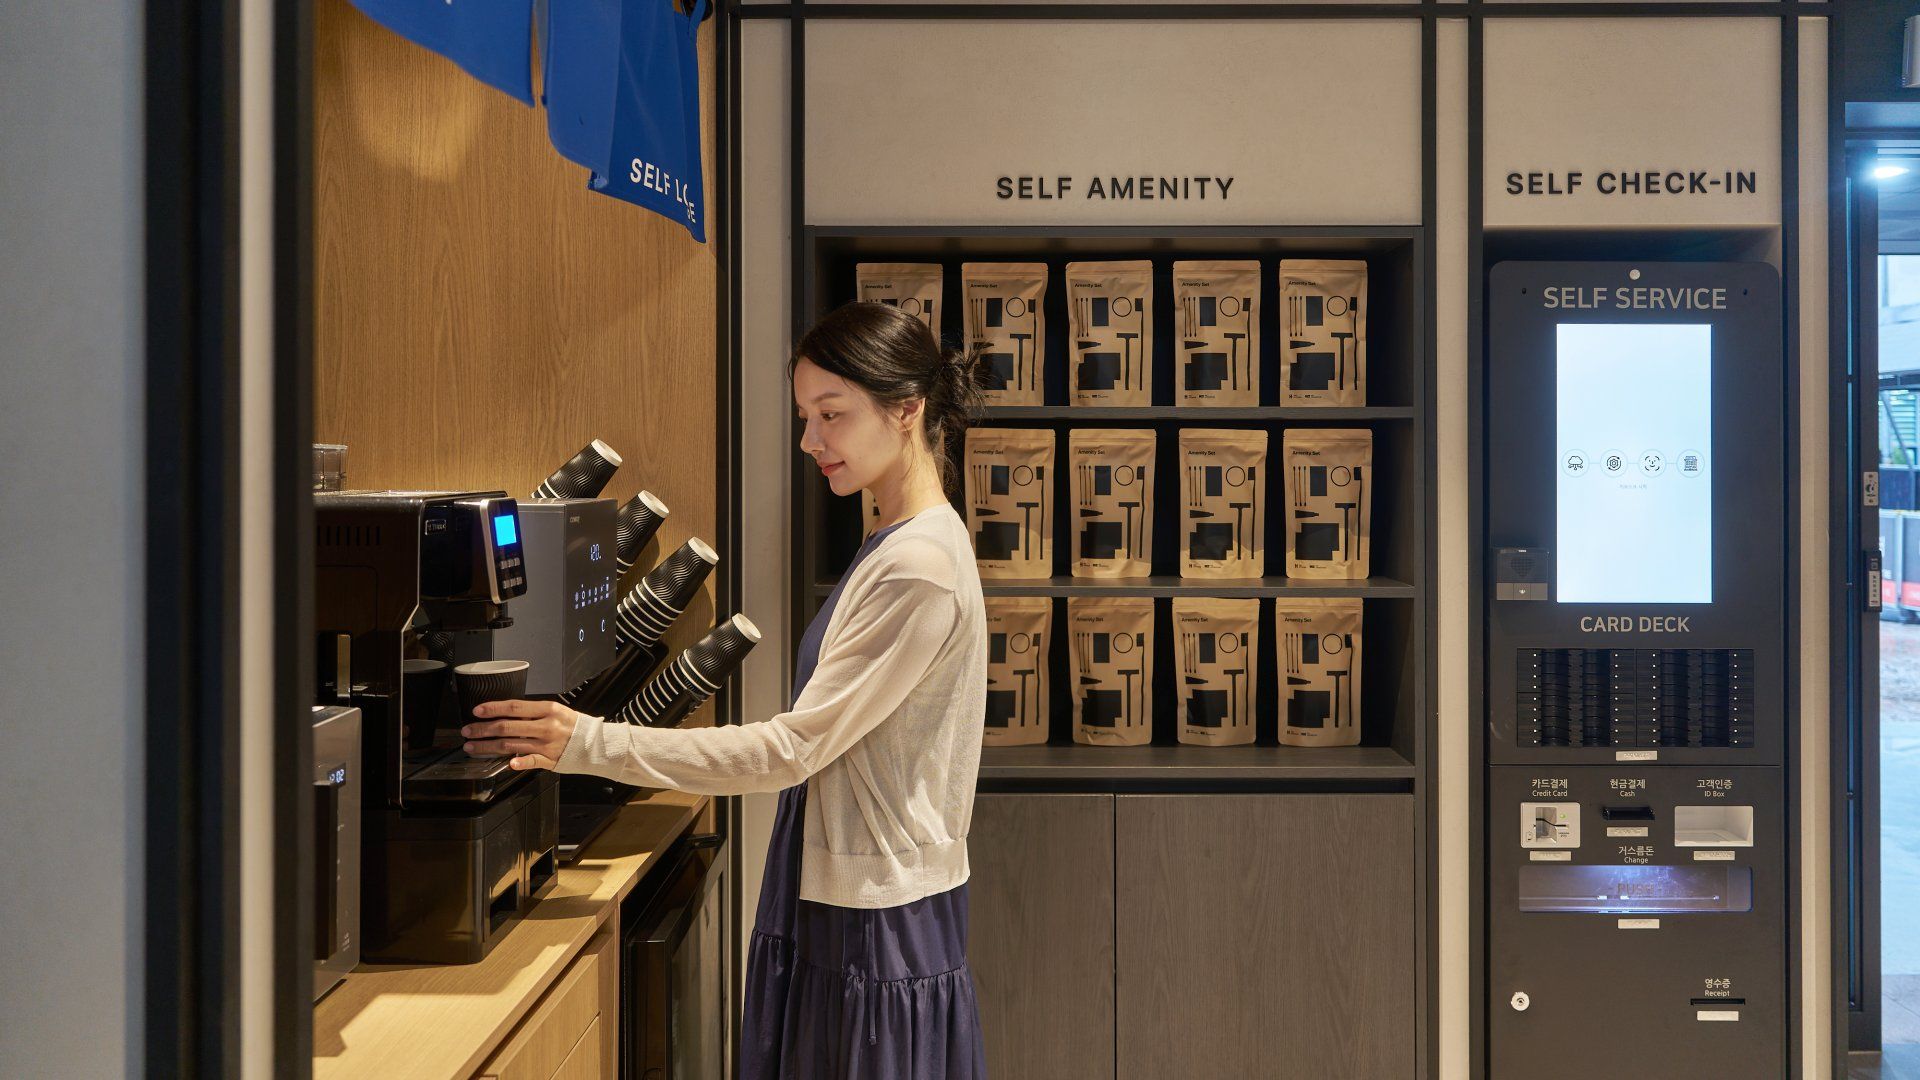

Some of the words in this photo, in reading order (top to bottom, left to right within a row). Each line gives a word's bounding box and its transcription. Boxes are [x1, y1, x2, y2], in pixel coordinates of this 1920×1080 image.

[630, 157, 671, 196] SELF
[996, 176, 1073, 200] SELF
[1086, 176, 1235, 200] AMENITY
[1506, 172, 1583, 195] SELF
[1596, 172, 1757, 195] CHECK-IN
[1543, 286, 1608, 309] SELF
[1615, 286, 1727, 310] SERVICE
[1580, 616, 1633, 633] CARD
[1639, 616, 1691, 633] DECK
[1531, 778, 1568, 789] 카드결제
[1609, 778, 1646, 789] 현금결제
[1696, 778, 1733, 789] 고객인증
[1618, 845, 1655, 856] 거스름돈
[1617, 883, 1655, 894] PUSH
[1704, 978, 1731, 989] 영수증
[1704, 989, 1730, 997] Receipt
